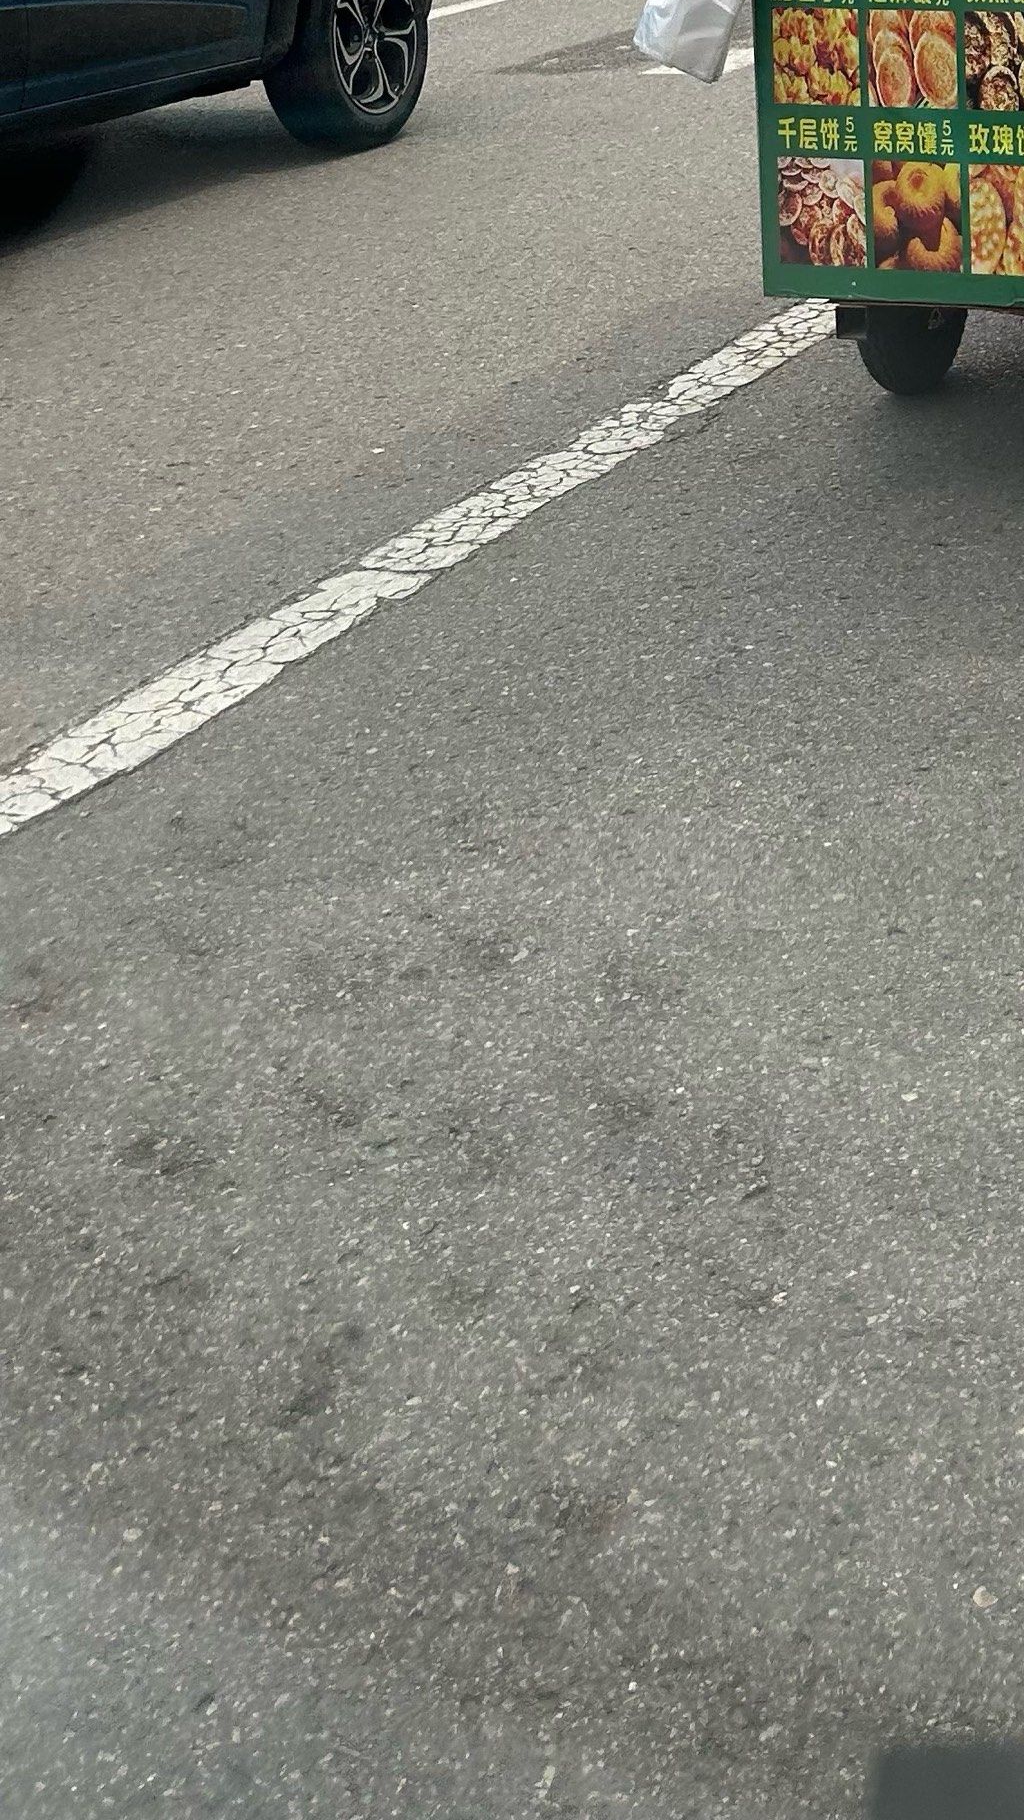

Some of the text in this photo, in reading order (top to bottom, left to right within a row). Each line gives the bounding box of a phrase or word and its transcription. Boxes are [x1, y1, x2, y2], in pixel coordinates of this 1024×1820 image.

[777, 117, 840, 150] 千层饼
[873, 120, 938, 155] 窝窝馕
